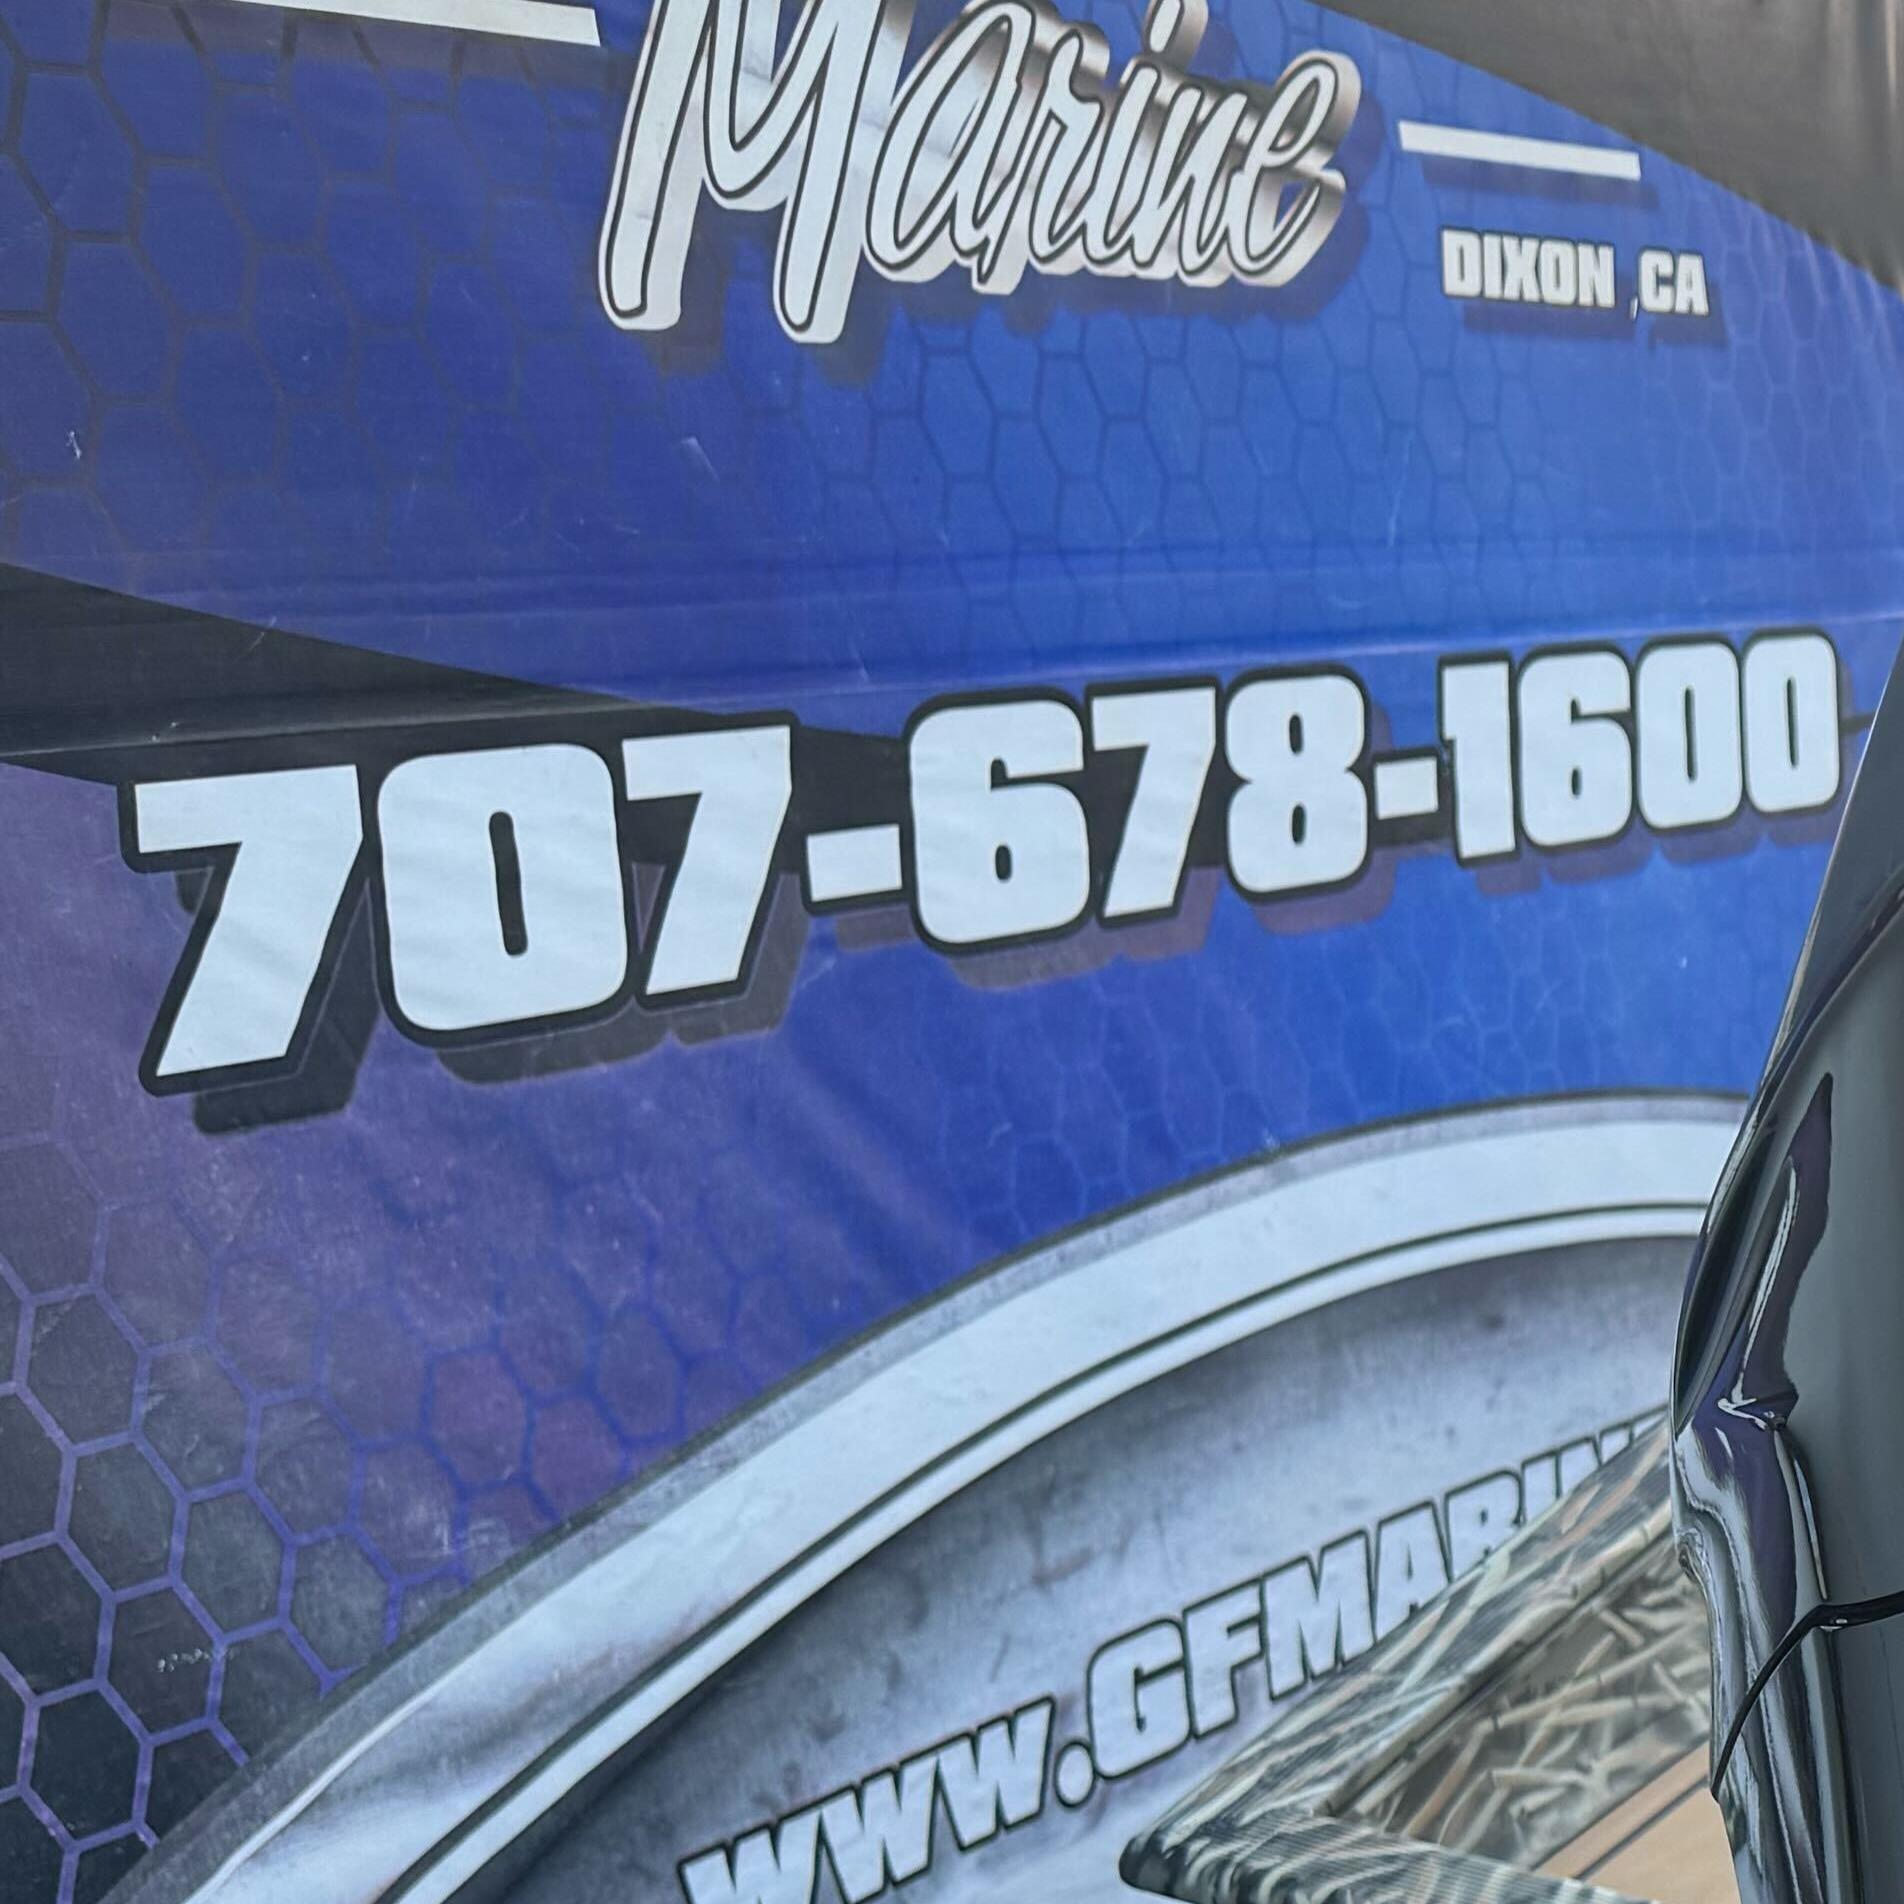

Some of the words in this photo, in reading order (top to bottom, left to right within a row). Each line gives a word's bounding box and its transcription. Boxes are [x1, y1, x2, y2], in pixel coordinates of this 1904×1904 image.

[600, 0, 1376, 344] Marine
[1440, 224, 1617, 309] DIXON
[127, 630, 1846, 1093] 707-678-1600
